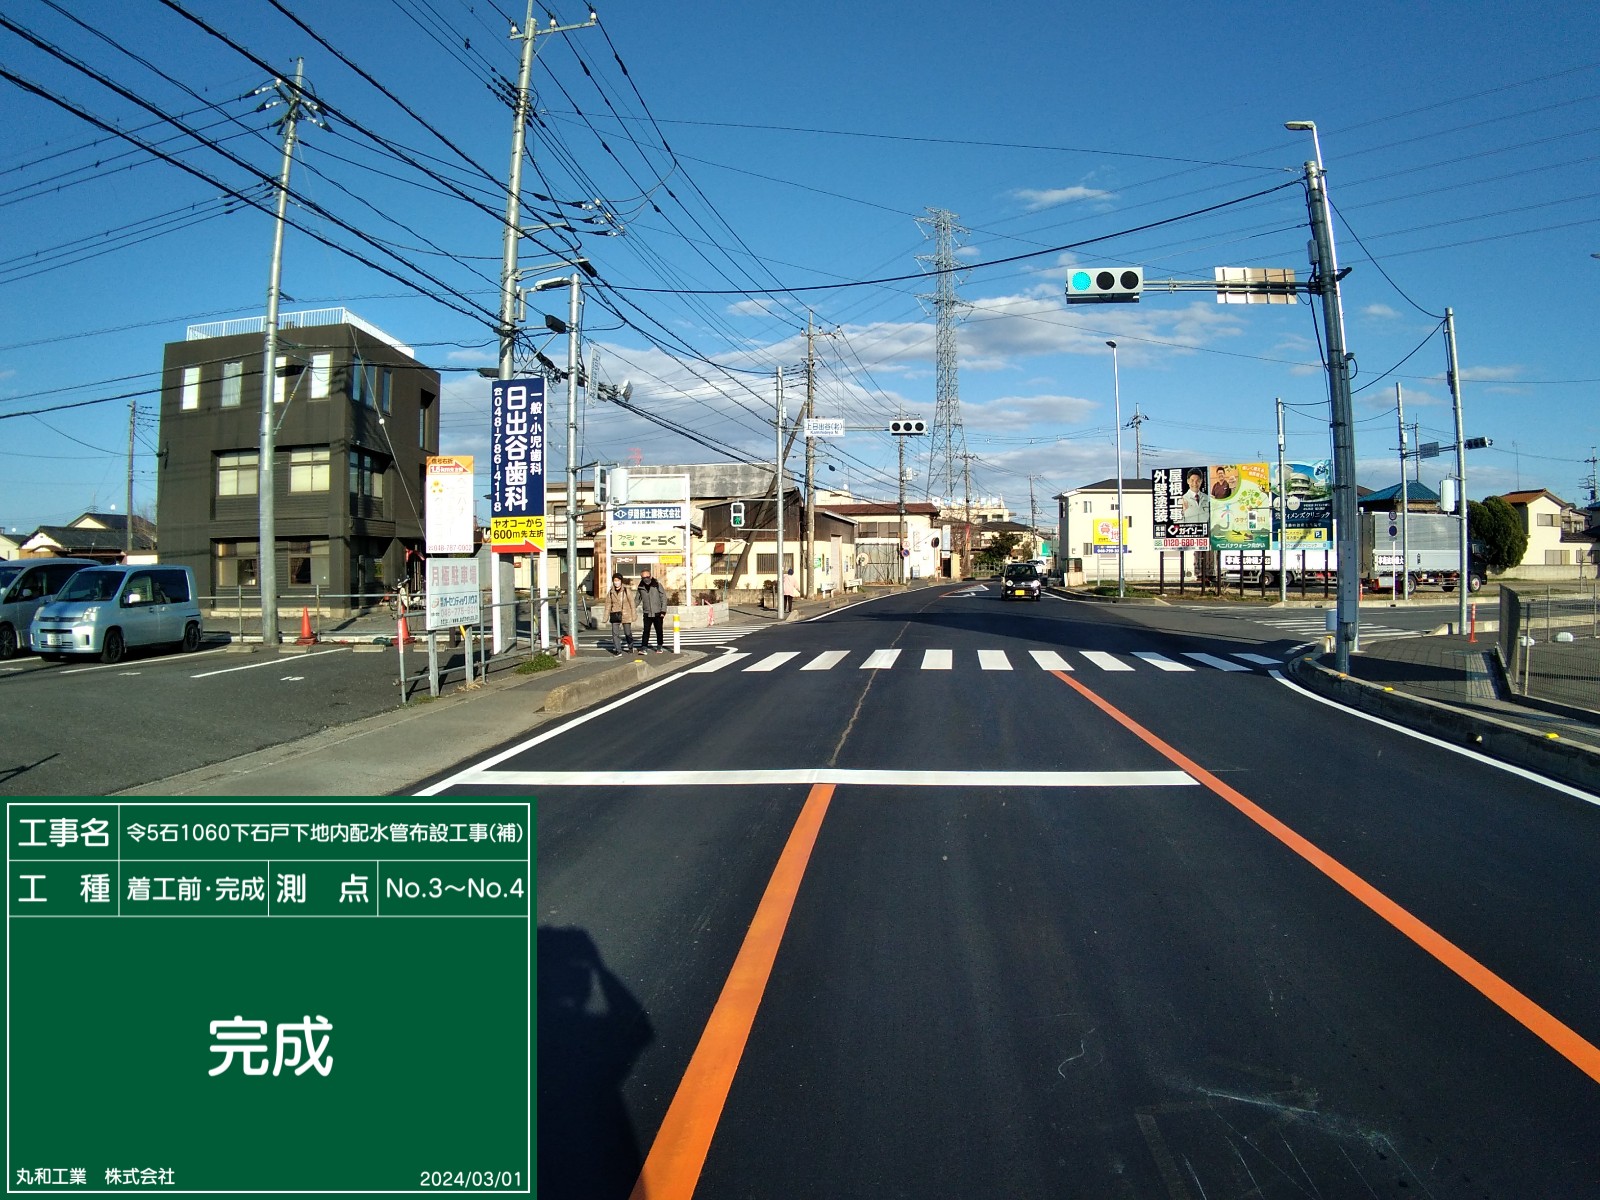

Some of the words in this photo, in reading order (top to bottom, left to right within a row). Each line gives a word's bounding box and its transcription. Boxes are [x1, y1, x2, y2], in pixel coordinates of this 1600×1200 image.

[505, 386, 528, 512] 日出谷歯科
[530, 391, 542, 476] 一般・小児歯科
[806, 422, 843, 431] 上日出谷(北)
[493, 396, 503, 512] 048-786-4118
[1154, 469, 1168, 522] 外壁塗装
[1169, 469, 1183, 522] 屋根工事
[494, 518, 543, 528] ヤオコーから
[1179, 527, 1203, 535] ガイソー
[432, 565, 477, 587] 月極駐車場
